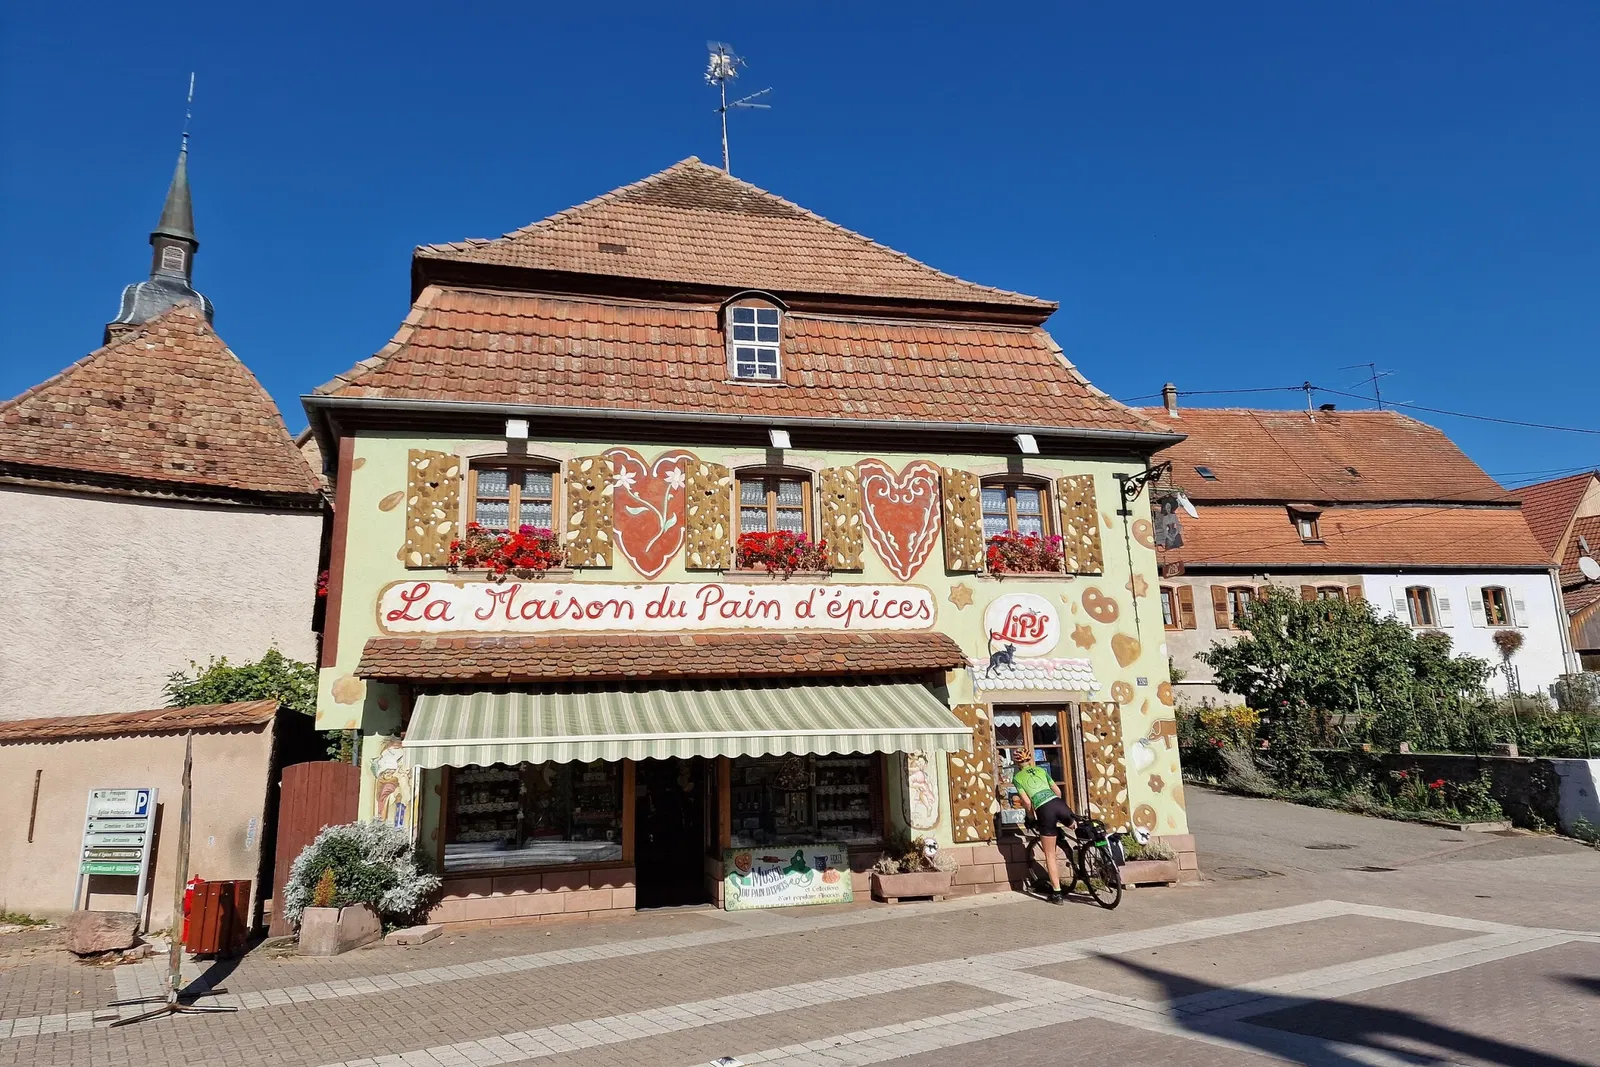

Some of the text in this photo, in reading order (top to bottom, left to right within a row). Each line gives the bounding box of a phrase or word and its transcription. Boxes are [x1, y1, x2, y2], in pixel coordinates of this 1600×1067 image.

[386, 582, 931, 628] La Maison du Pain d'épices
[136, 792, 148, 813] P
[741, 887, 750, 897] DU
[750, 886, 766, 897] PAIN
[793, 893, 817, 902] populaire
